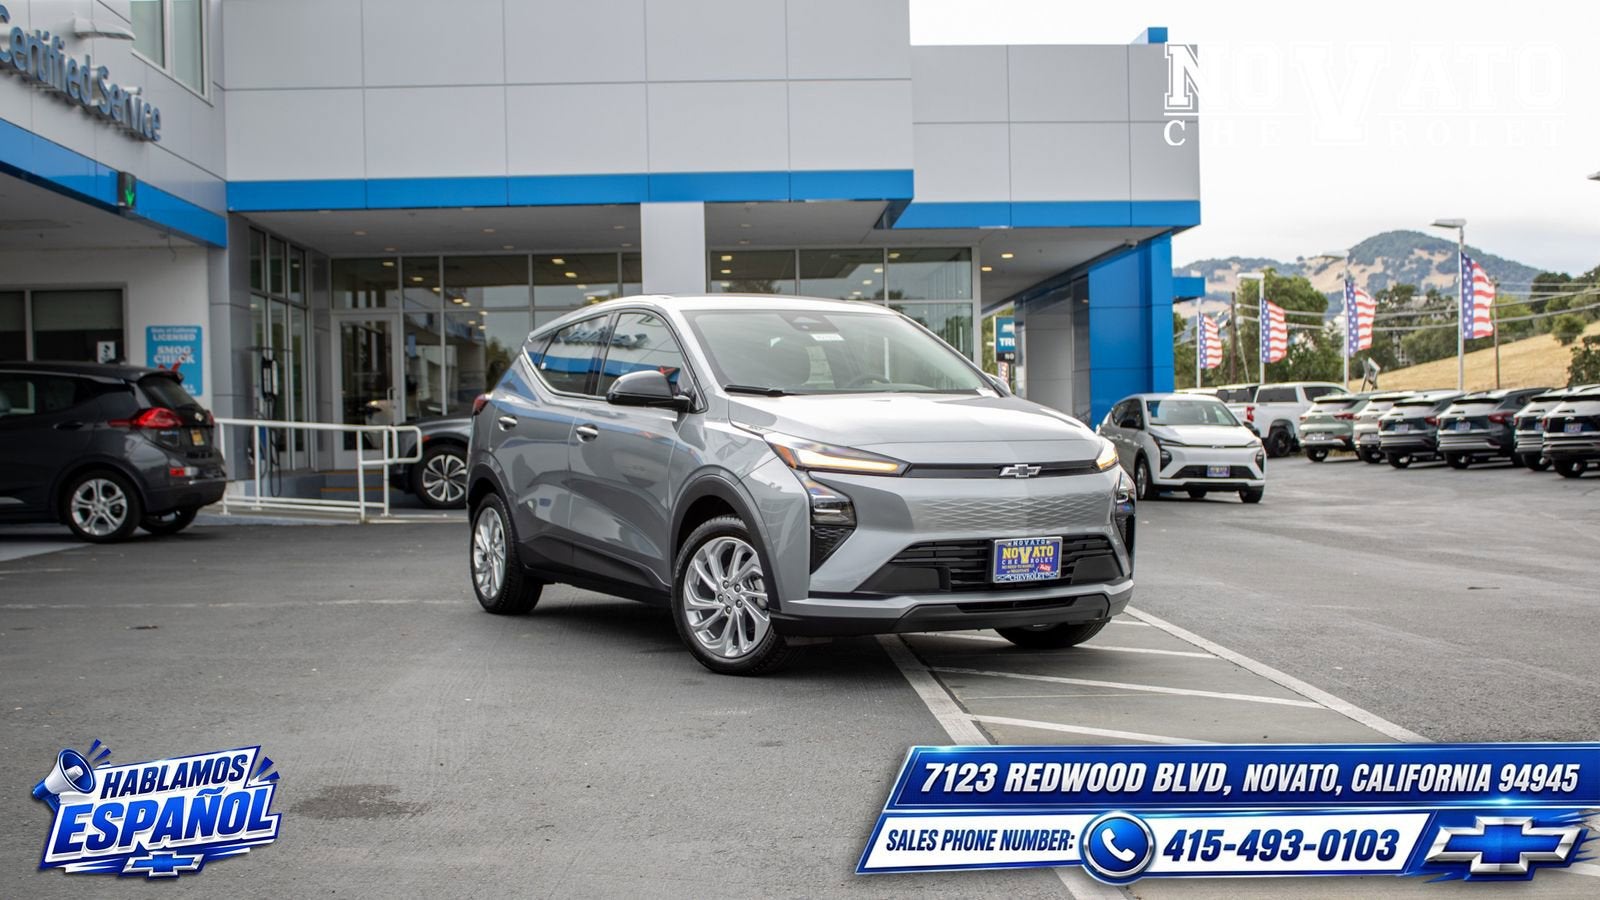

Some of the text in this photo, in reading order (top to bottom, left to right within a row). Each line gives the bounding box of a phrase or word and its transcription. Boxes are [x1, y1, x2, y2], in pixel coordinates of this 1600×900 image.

[97, 65, 161, 142] Service
[157, 345, 192, 355] SMOG
[1002, 545, 1054, 564] NOVATO
[1010, 571, 1045, 580] CHEVROLET
